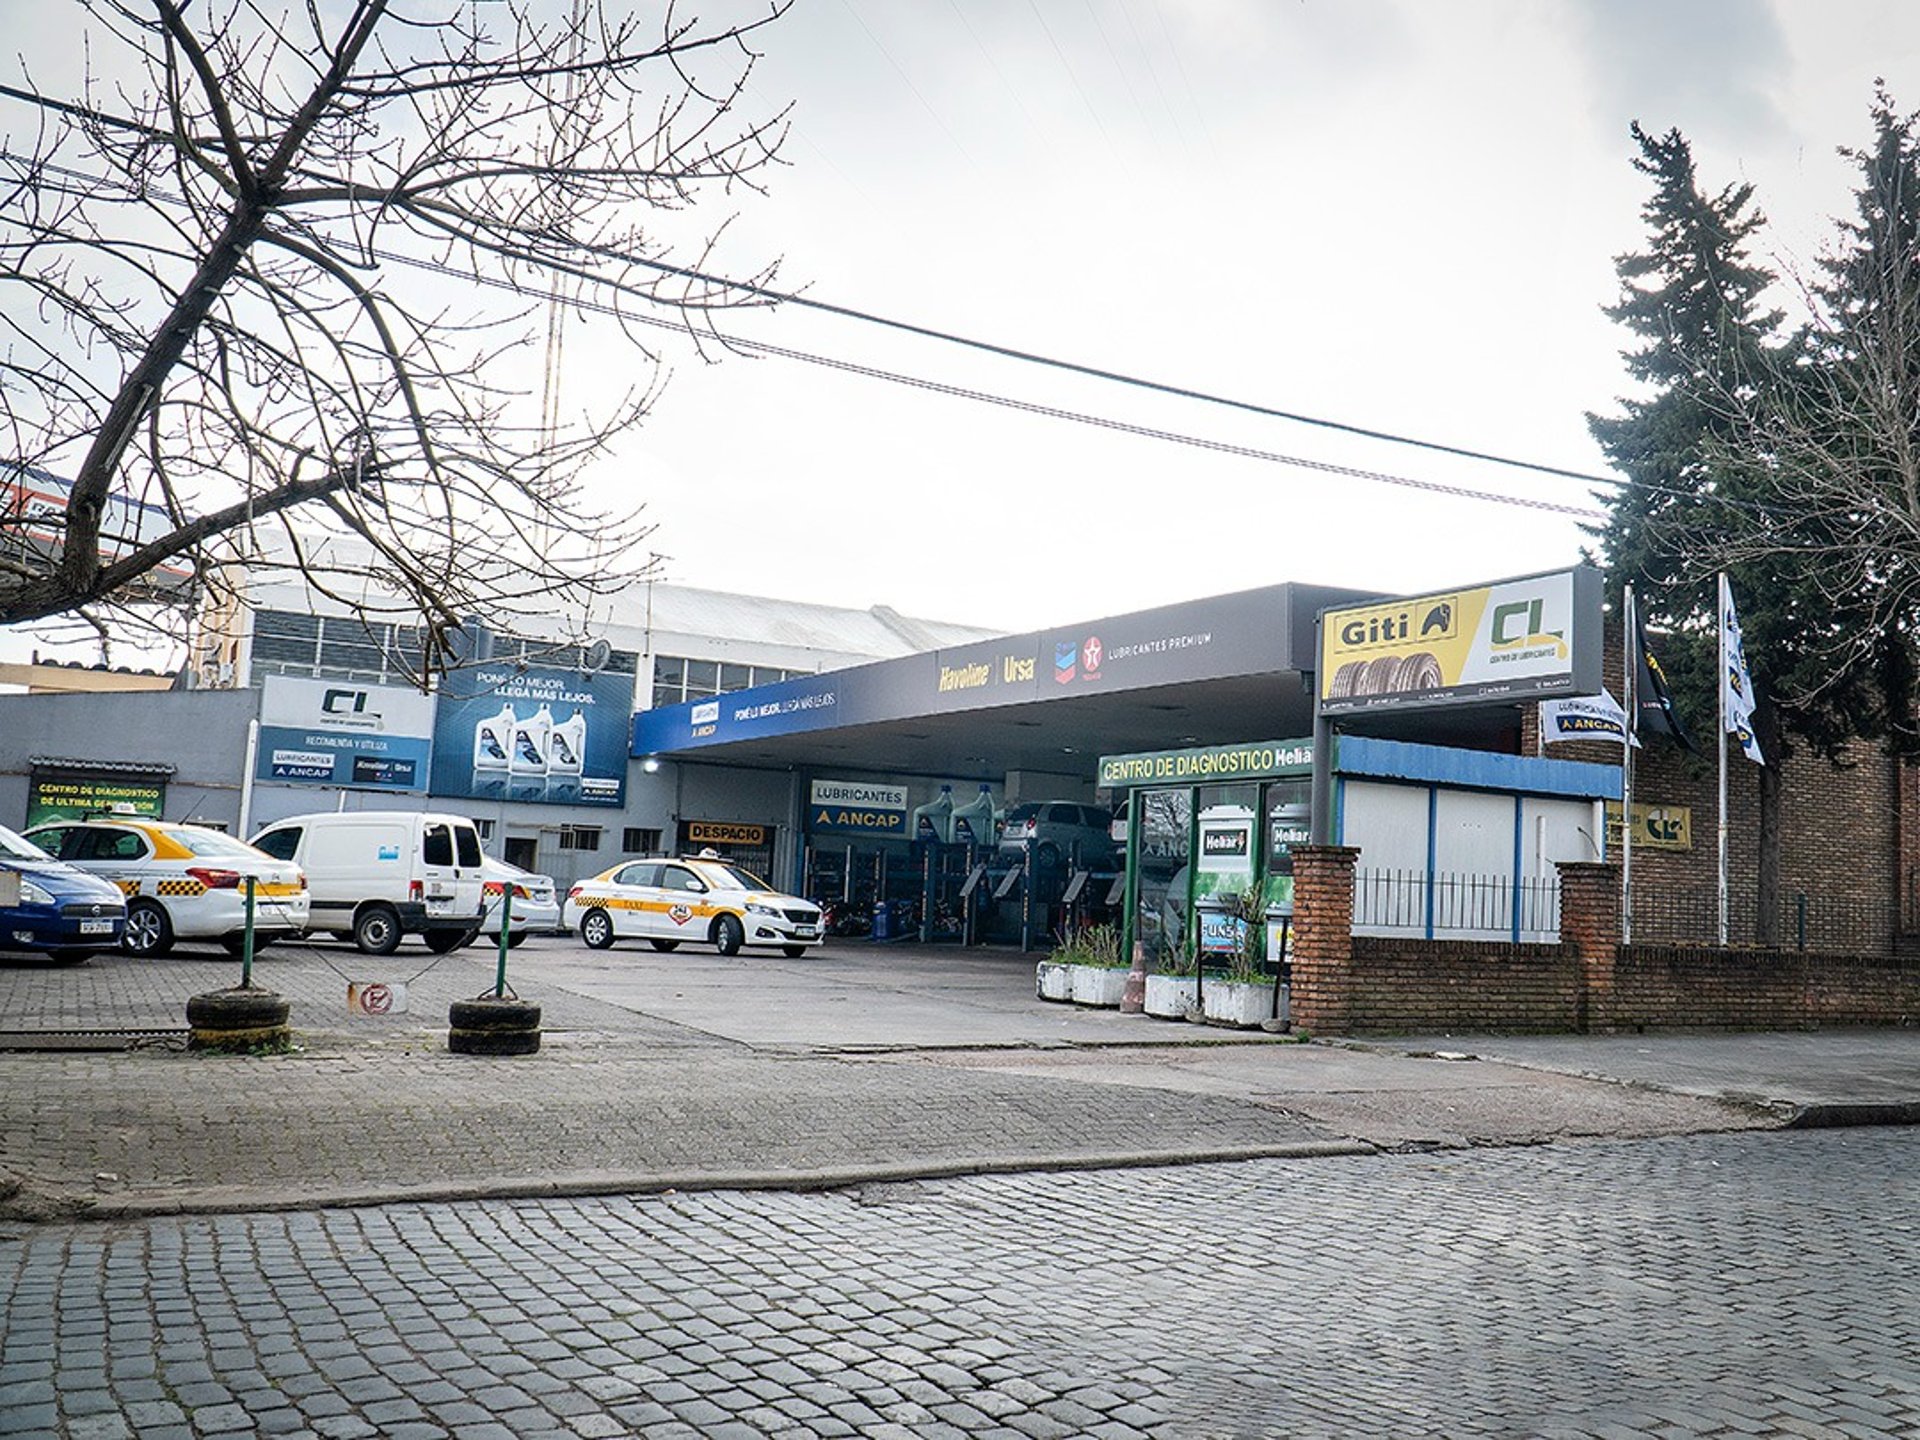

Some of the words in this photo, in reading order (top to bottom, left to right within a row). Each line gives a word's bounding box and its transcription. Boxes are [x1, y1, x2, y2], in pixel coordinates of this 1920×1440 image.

[1341, 613, 1408, 645] Giti
[1108, 640, 1167, 661] LUBRICANTES
[1168, 632, 1212, 650] PREMIUM
[939, 662, 989, 692] Havoline
[1004, 655, 1034, 684] Ursa
[1103, 760, 1152, 782] CENTRO
[1156, 757, 1174, 778] DE
[1176, 749, 1274, 776] DIAGNOSTICO
[1274, 746, 1312, 768] Helia
[288, 767, 331, 779] ANCAP
[38, 783, 79, 794] CENTRO
[79, 786, 94, 796] DE
[95, 787, 159, 799] DIAGNOSTICO
[816, 787, 903, 804] LUBRICANTES
[40, 796, 54, 806] DE
[836, 810, 902, 828] ANCAP
[692, 825, 761, 841] DESPACIO
[1274, 828, 1309, 843] Heliar
[1206, 834, 1237, 851] Heliar
